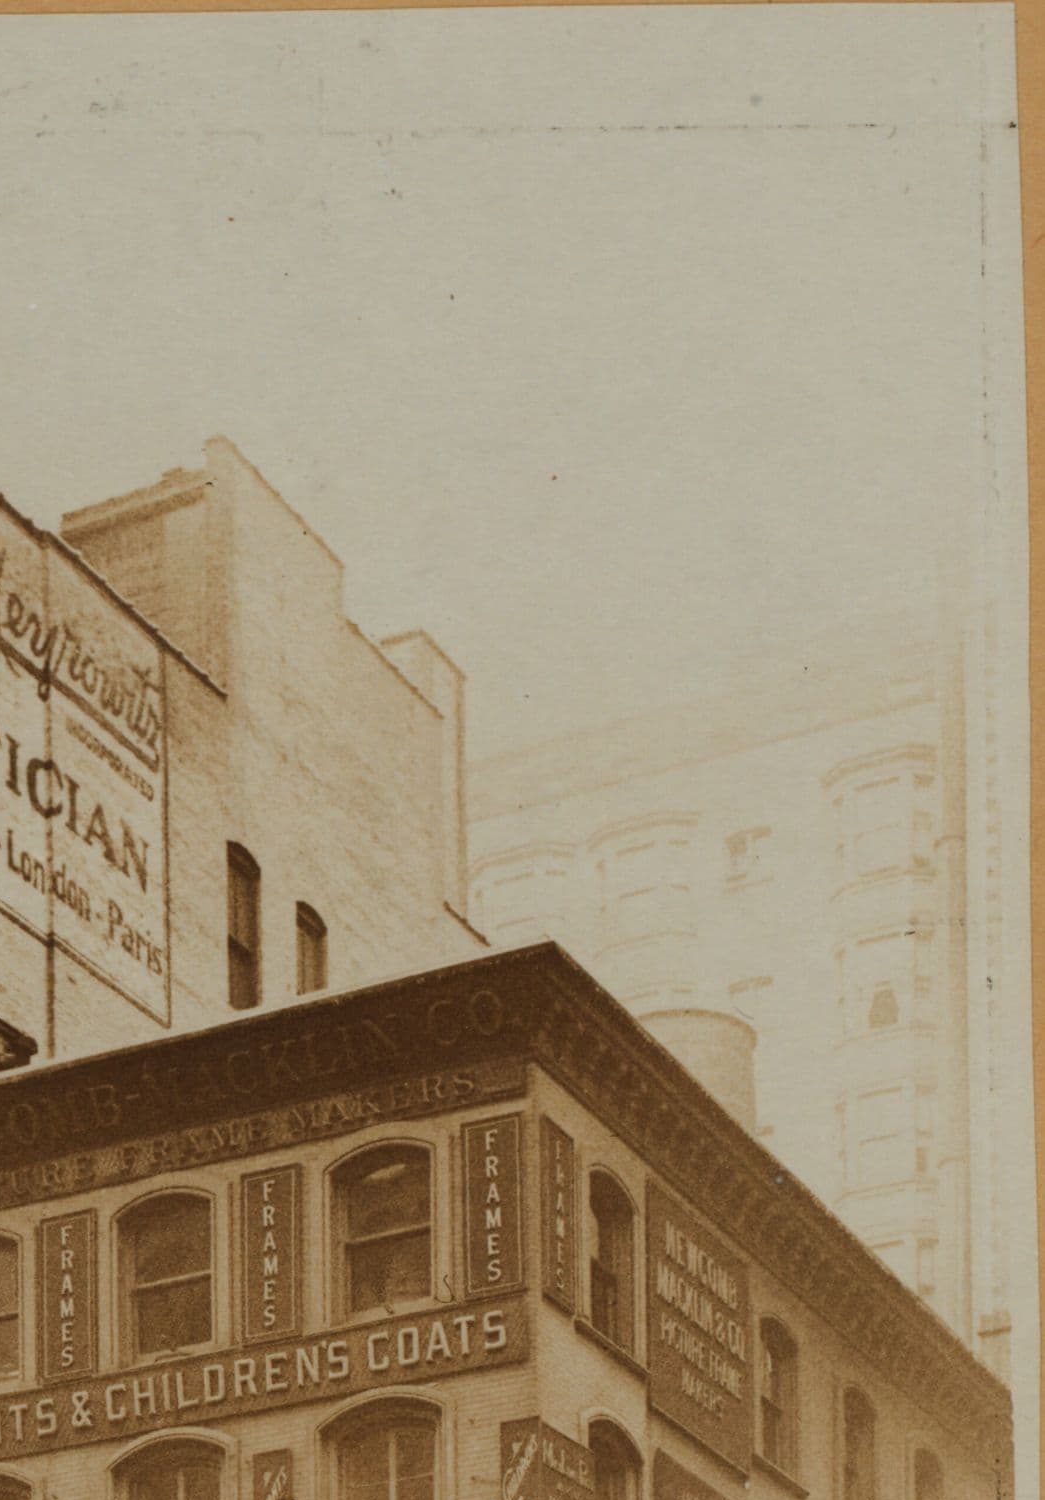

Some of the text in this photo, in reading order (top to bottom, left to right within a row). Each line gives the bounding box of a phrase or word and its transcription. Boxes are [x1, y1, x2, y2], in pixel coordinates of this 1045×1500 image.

[7, 828, 92, 925] London
[107, 898, 166, 979] Paris
[290, 1072, 478, 1136] MAKERS
[259, 1178, 279, 1328] FRAMES
[483, 1127, 503, 1283] FRAMES
[57, 1223, 77, 1369] FRAMES
[71, 1388, 94, 1429] &
[366, 1309, 509, 1372] COATS
[714, 1311, 726, 1345] &
